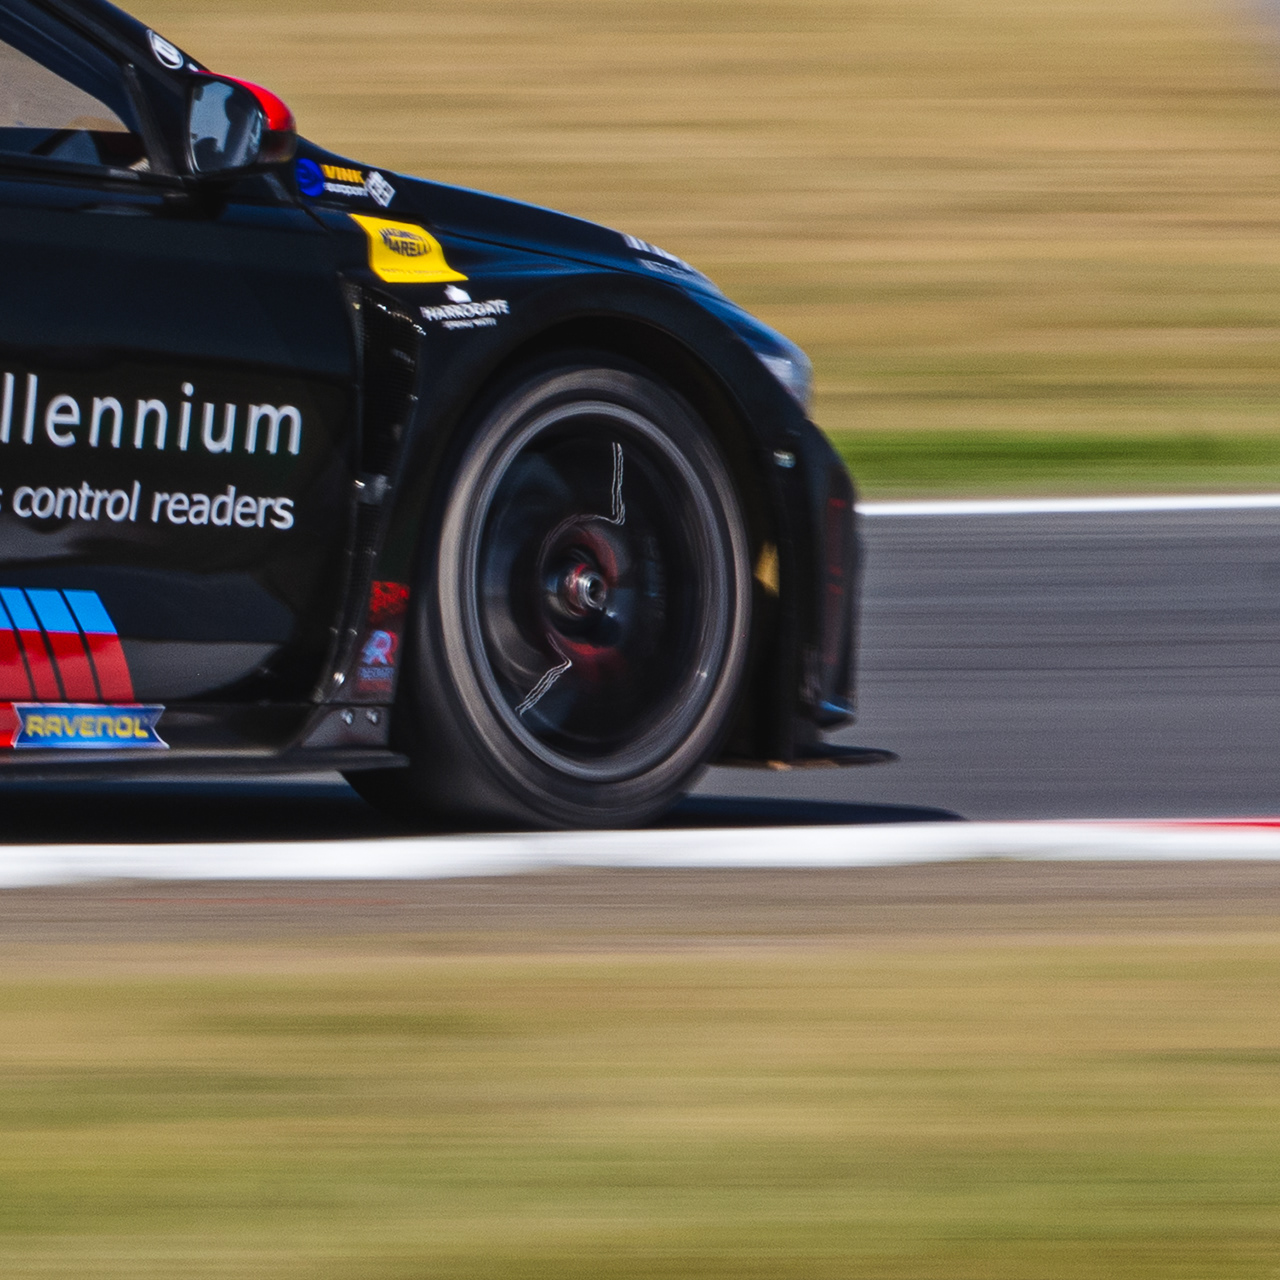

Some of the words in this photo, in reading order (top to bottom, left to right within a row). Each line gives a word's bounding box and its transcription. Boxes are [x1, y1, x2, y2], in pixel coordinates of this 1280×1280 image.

[12, 480, 140, 523] control
[151, 485, 296, 531] readers
[25, 713, 149, 739] RAVENOL
